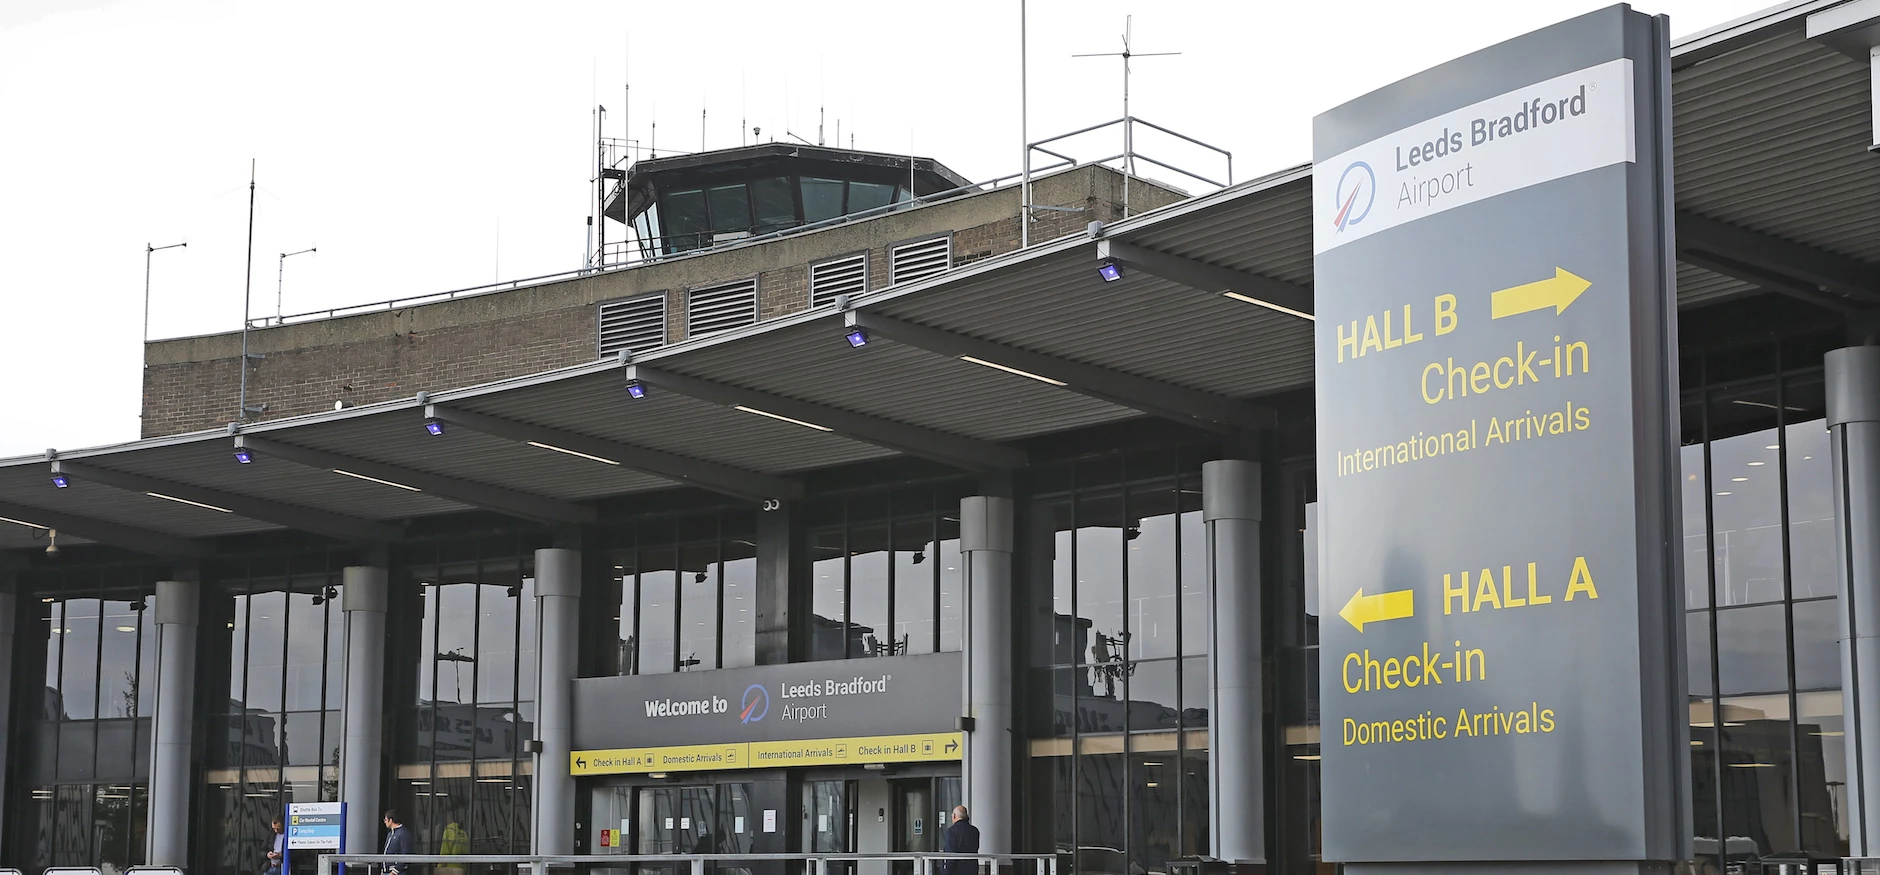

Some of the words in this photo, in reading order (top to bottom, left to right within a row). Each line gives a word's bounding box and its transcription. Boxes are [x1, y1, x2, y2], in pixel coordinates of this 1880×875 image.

[1396, 127, 1463, 172] Leeds
[1397, 162, 1474, 209] Airport
[1337, 303, 1424, 364] HALL
[1434, 293, 1458, 337] B
[1421, 335, 1589, 404] Check-in
[1337, 419, 1476, 477] International
[1485, 401, 1591, 447] Arrivals
[1443, 562, 1552, 615] HALL
[1564, 556, 1599, 602] A
[1342, 640, 1486, 694] Check-in
[645, 699, 709, 717] Welcome
[713, 695, 728, 714] to
[781, 682, 822, 699] Leeds
[781, 703, 827, 723] Airport
[1343, 710, 1447, 746] Domestic
[1454, 701, 1555, 738] Arrivals
[593, 758, 613, 767] Check
[615, 758, 621, 766] in
[622, 757, 635, 766] Hall
[637, 757, 642, 765] A
[663, 755, 694, 764] Domestic
[696, 753, 722, 763] Arrivals
[758, 748, 803, 759] International
[805, 747, 833, 758] Arrivals
[858, 745, 883, 756] Check
[884, 745, 891, 754] in
[893, 744, 909, 754] Hall
[910, 744, 916, 753] B
